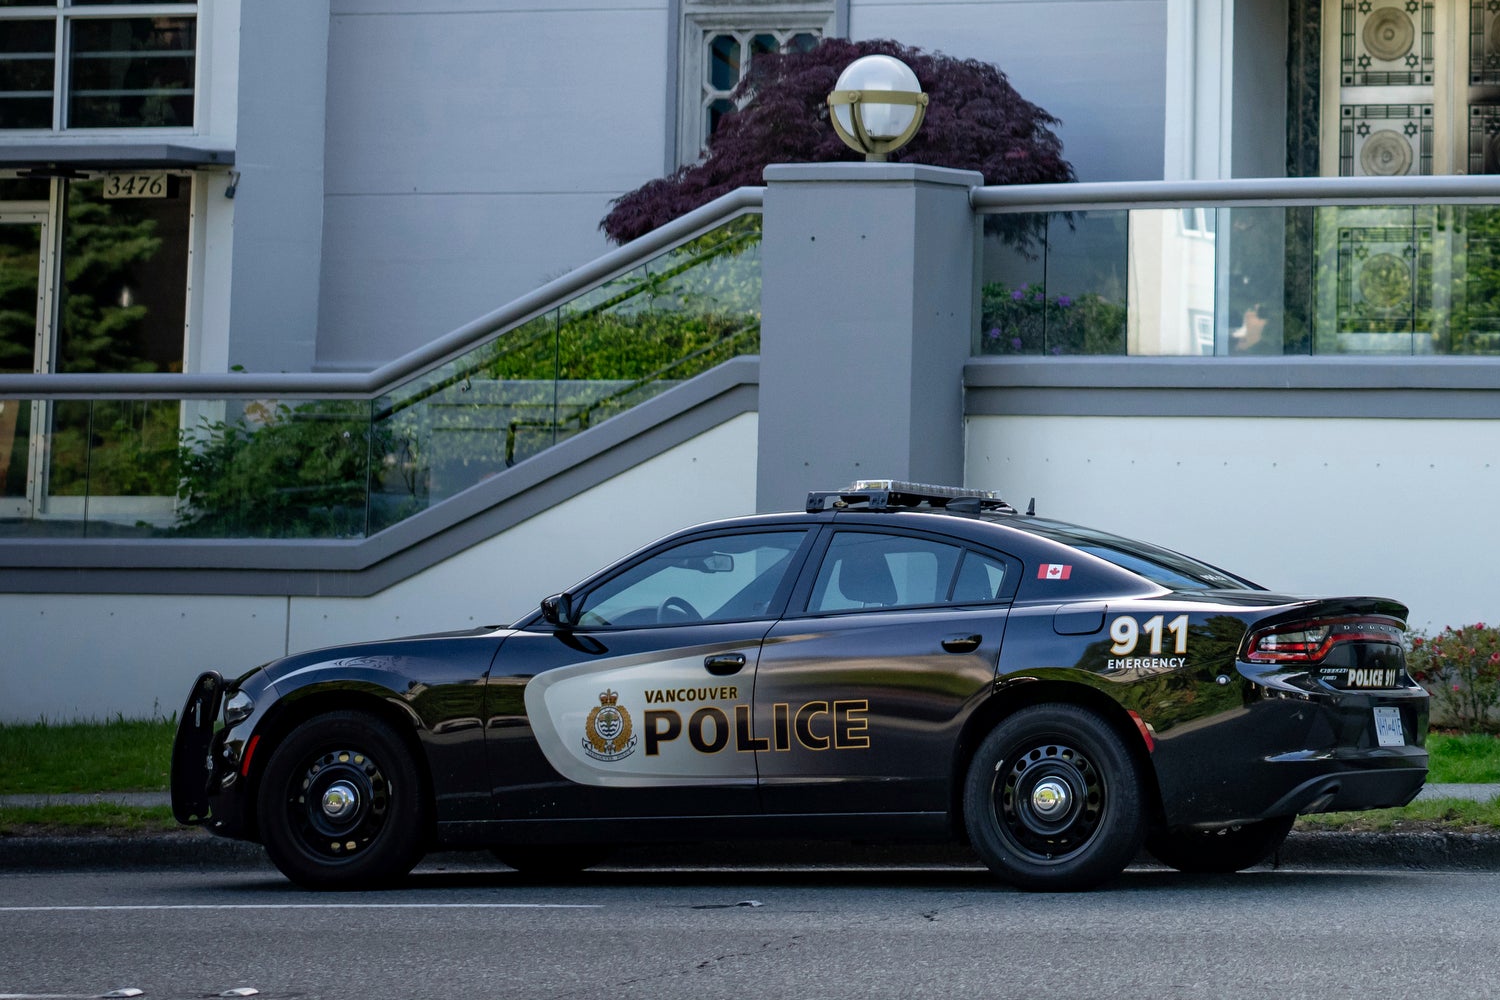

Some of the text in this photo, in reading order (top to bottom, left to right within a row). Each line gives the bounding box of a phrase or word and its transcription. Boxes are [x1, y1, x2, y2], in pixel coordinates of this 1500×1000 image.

[107, 175, 163, 196] 3476
[1109, 614, 1189, 656] 911
[1107, 657, 1186, 669] EMERGENCY
[1347, 668, 1396, 687] POLICE 911
[644, 686, 738, 704] VANCOUVER
[643, 699, 870, 757] POLICE
